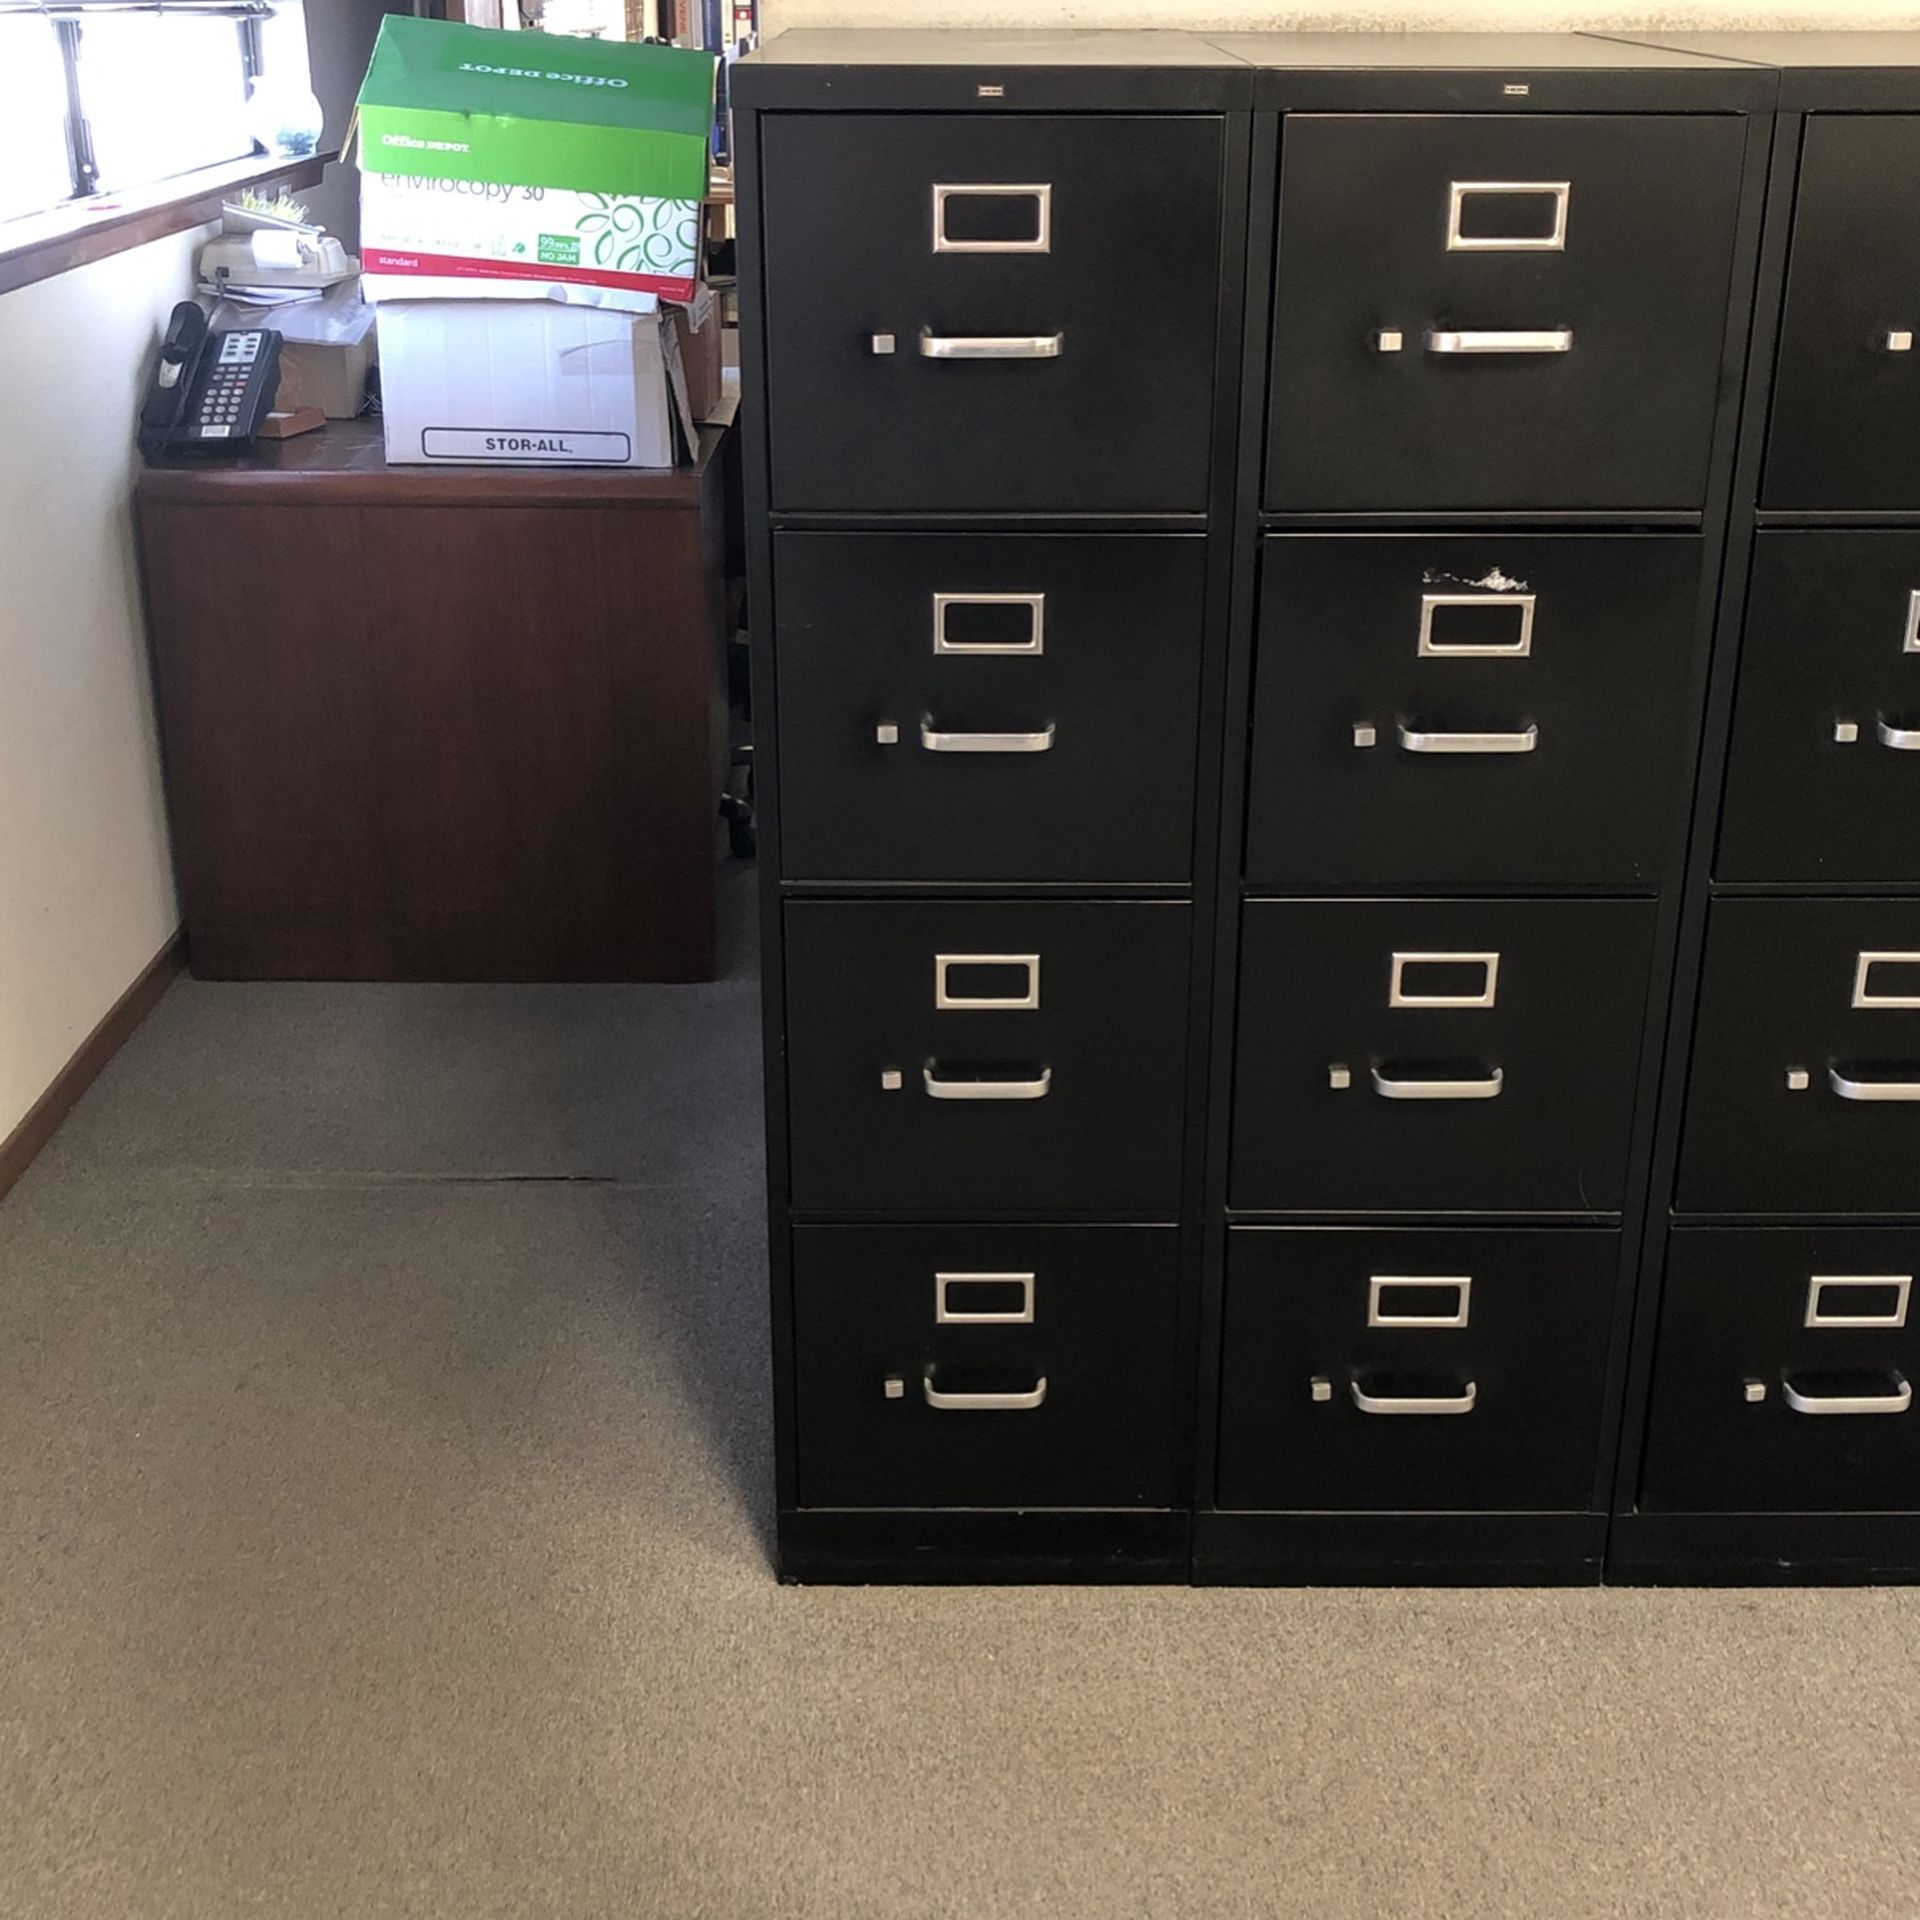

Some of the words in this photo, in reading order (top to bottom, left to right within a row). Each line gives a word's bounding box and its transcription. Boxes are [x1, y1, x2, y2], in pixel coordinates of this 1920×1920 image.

[458, 63, 541, 79] DEPOT
[545, 72, 629, 88] Office
[381, 134, 425, 149] Office
[381, 173, 515, 204] envirocopy
[378, 256, 418, 268] standard
